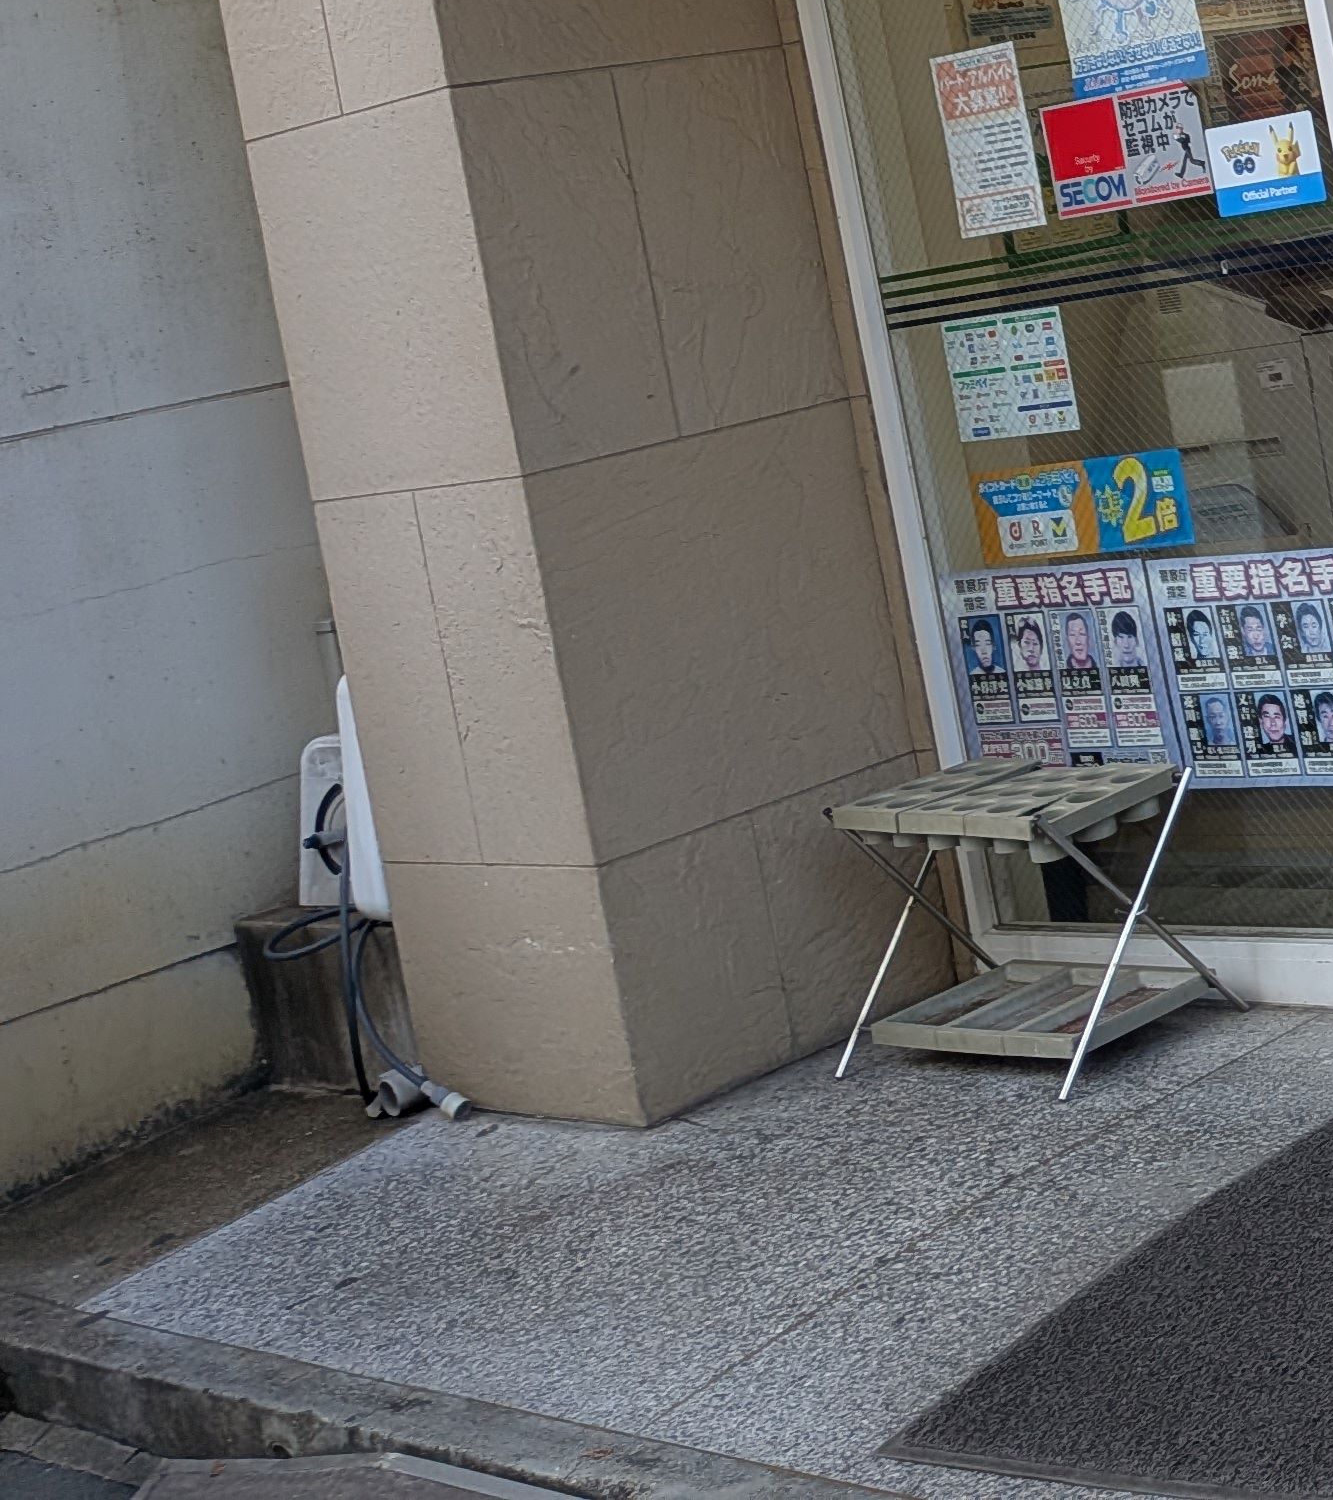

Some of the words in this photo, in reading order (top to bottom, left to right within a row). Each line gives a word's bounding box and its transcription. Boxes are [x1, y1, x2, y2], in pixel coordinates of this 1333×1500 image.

[1119, 90, 1195, 120] 防犯カメラで
[1123, 112, 1177, 138] セコムが
[1126, 134, 1170, 157] 監視中
[1233, 156, 1256, 176] GO
[1060, 174, 1128, 208] SECOM
[1134, 182, 1170, 196] Monitored
[1182, 176, 1210, 188] Camera
[1242, 186, 1269, 202] Official
[1269, 184, 1299, 200] Partner
[993, 568, 1134, 610] 重要指名手配
